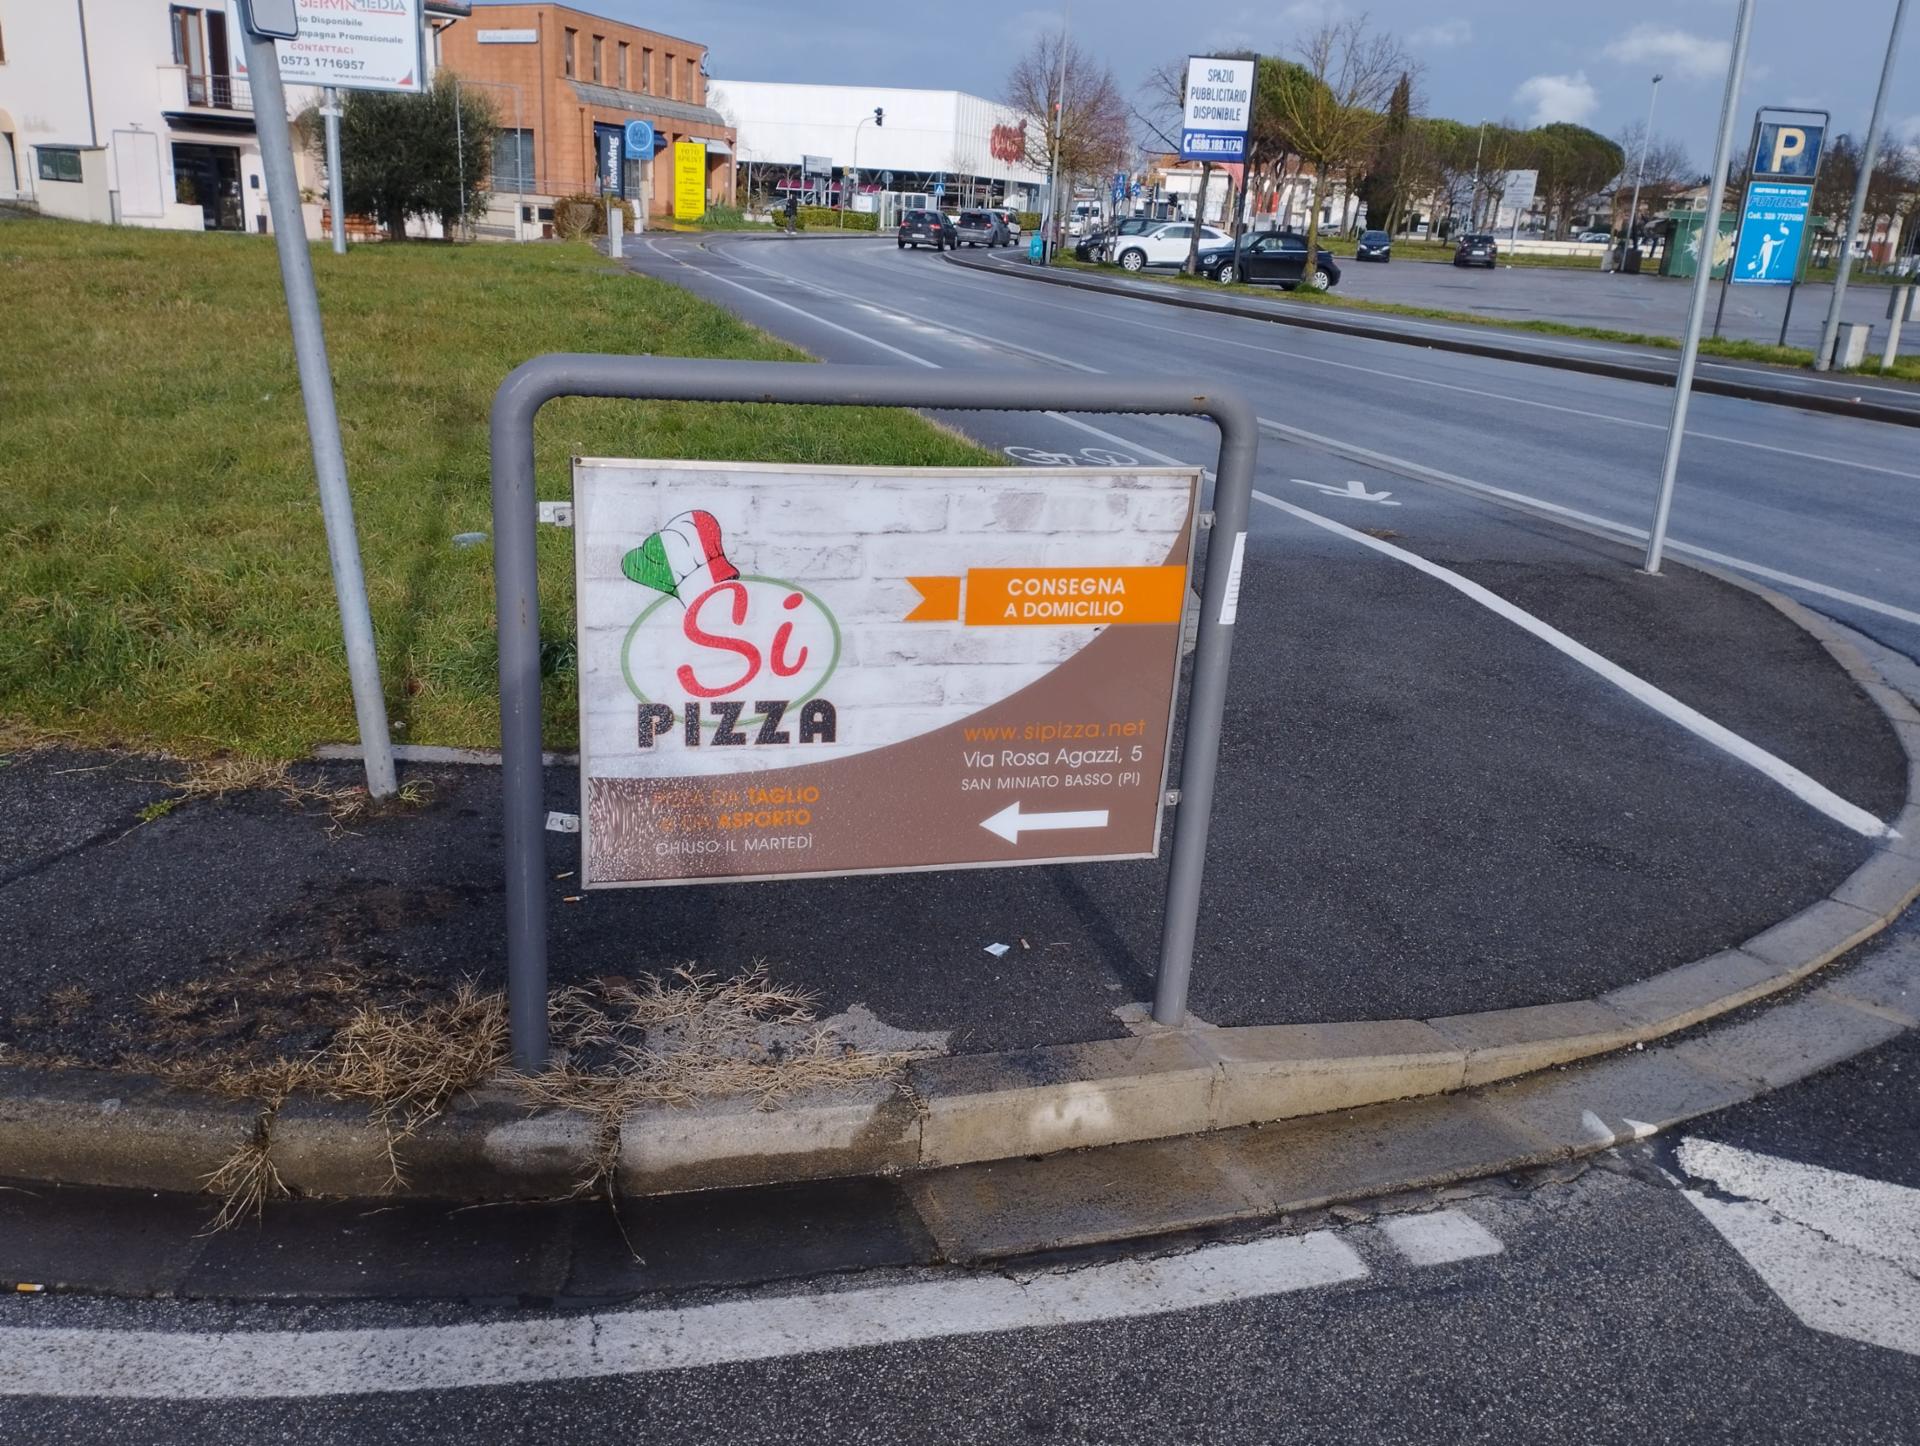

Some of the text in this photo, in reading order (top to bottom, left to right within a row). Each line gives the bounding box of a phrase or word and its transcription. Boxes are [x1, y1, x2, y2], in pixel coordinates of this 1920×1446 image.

[311, 15, 363, 27] Disponibile
[299, 30, 404, 45] mpagna Promozionale
[290, 43, 354, 55] CONTATTACI
[281, 55, 366, 71] 0573 1716957
[1207, 68, 1235, 84] SPAZIO
[1190, 86, 1248, 103] PUBBLICITARIO
[1193, 106, 1241, 121] DISPONIBILE
[1770, 127, 1806, 173] P
[1007, 577, 1126, 596] CONSEGNA
[1004, 600, 1124, 618] A DOMICILIO
[676, 582, 808, 697] Si
[637, 699, 837, 748] PIZZA
[963, 719, 1146, 742] www.sipizza.net
[962, 745, 1143, 768] Via Rosa Agazzi, 5
[961, 772, 1141, 790] SAN MINIATO BASSO (PI)
[748, 786, 820, 805] TAGLIO
[717, 808, 812, 830] ASPORTO
[655, 833, 813, 855] CHIUSO IL MARTEDÌ
